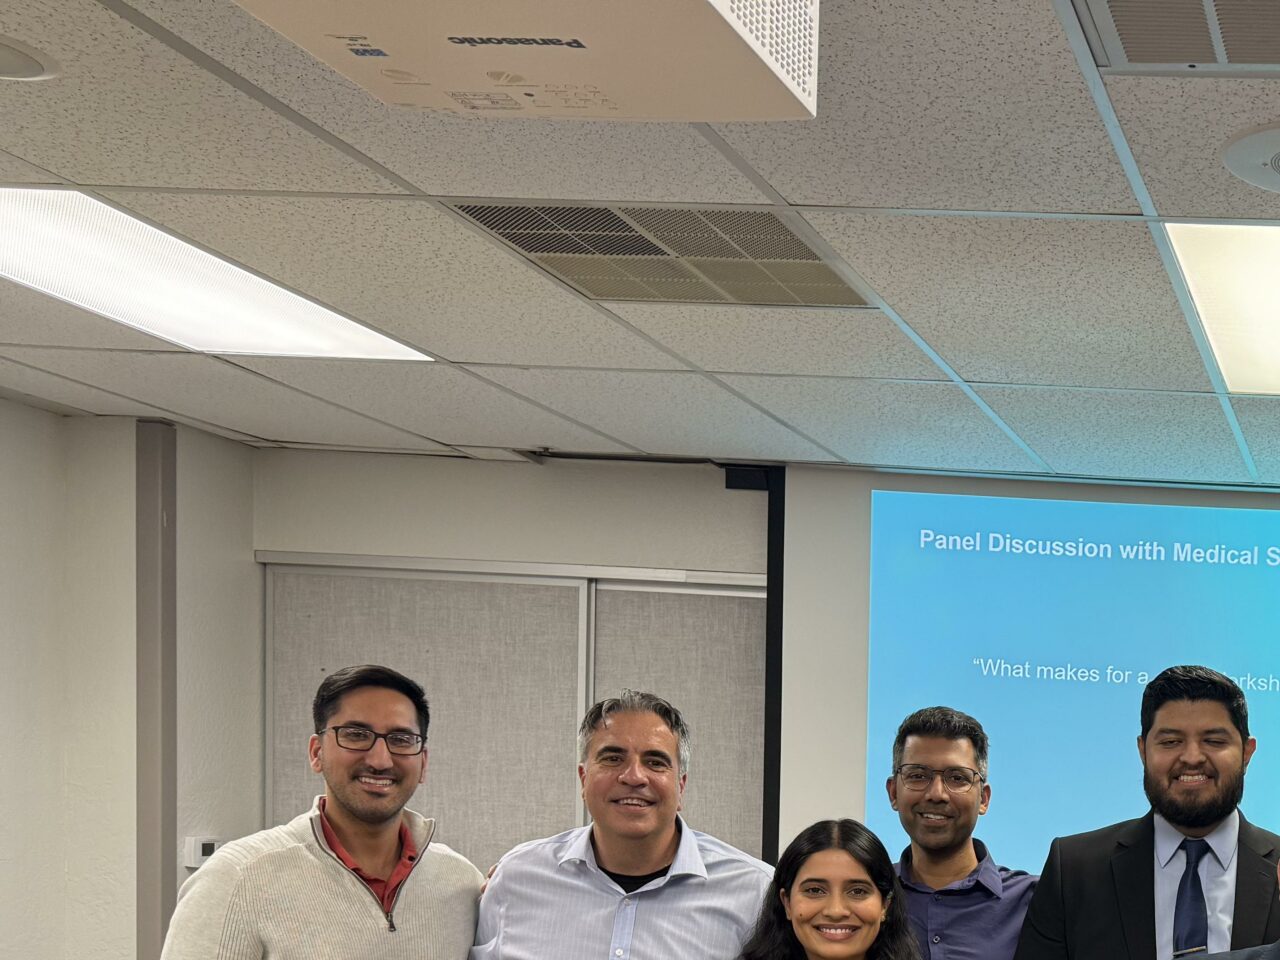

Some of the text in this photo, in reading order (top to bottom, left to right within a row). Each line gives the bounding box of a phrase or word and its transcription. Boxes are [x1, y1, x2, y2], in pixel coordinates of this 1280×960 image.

[448, 37, 586, 49] Panasonic
[919, 529, 981, 551] Panel
[988, 533, 1112, 558] Discussion
[1119, 541, 1165, 561] with
[1173, 543, 1259, 566] Medical
[1037, 664, 1100, 682] makes
[1106, 666, 1132, 683] for
[1137, 671, 1149, 685] a
